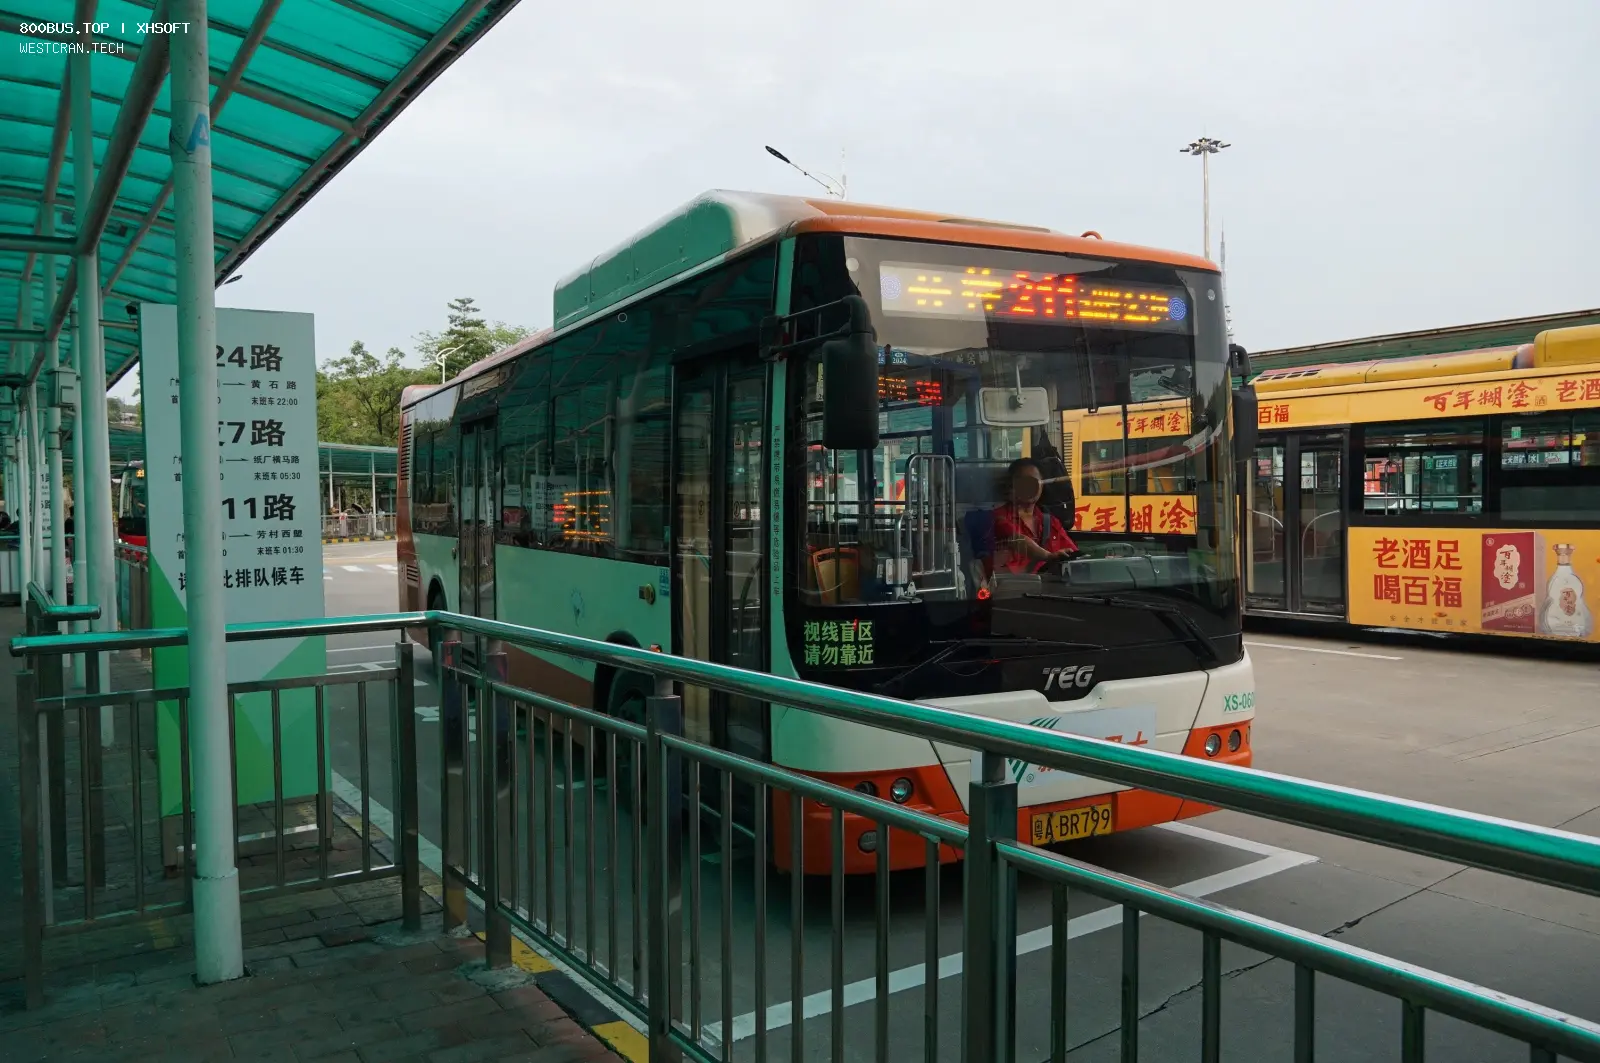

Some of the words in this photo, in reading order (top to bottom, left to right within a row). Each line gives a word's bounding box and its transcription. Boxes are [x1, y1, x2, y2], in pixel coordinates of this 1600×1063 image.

[251, 379, 297, 390] 黄石路
[251, 396, 275, 406] 末班车
[276, 397, 298, 406] 22:00
[1258, 404, 1289, 423] 百福
[253, 455, 300, 464] 纸厂横马路
[254, 472, 278, 481] 末班车
[279, 472, 301, 480] 05:30
[257, 546, 280, 556] 末班车
[282, 546, 304, 554] 01:30
[1372, 537, 1463, 571] 老酒足
[178, 566, 305, 590] 此排队候车
[1373, 574, 1463, 608] 喝百福
[803, 620, 874, 642] 视线盲区
[803, 643, 874, 666] 请勿靠近
[1042, 664, 1095, 690] TEG
